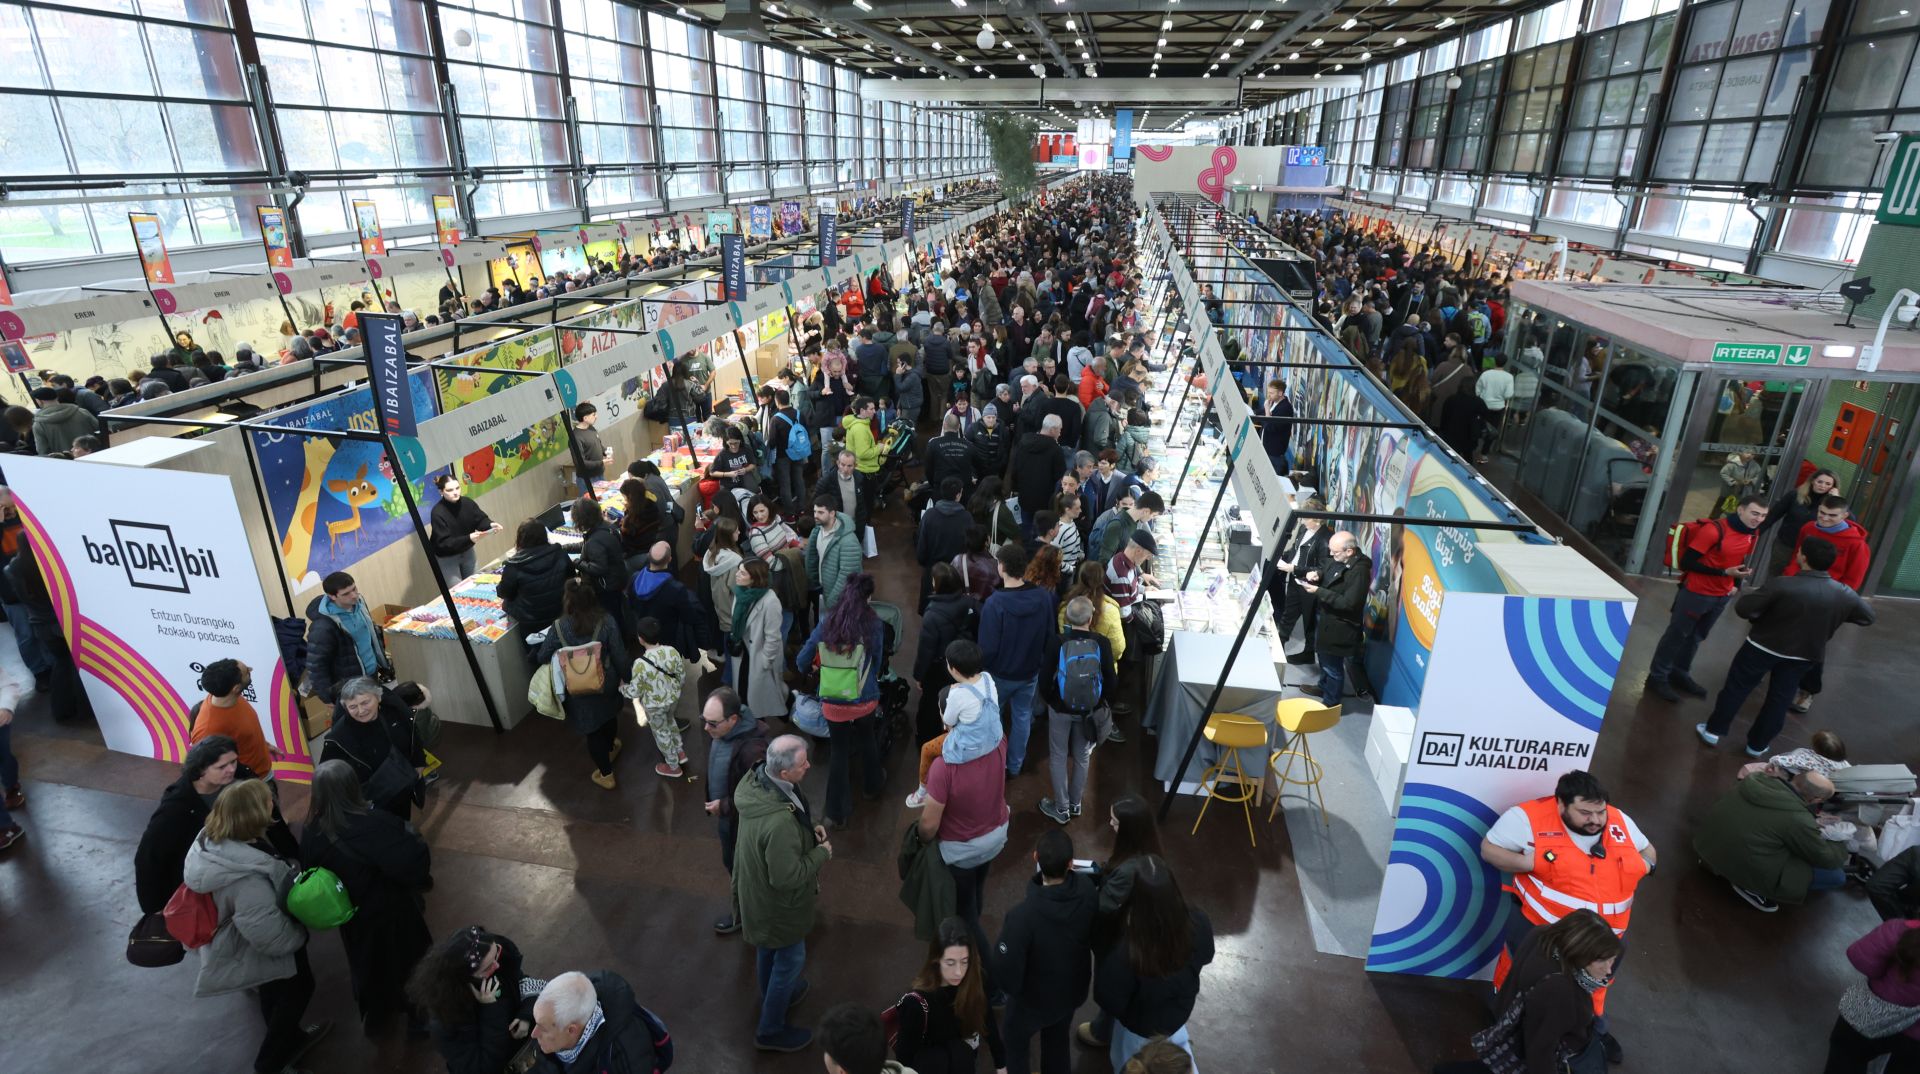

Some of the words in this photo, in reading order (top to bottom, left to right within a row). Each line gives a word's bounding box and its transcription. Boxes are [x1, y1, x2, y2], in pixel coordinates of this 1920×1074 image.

[824, 218, 835, 259] IBAIZABAL
[730, 239, 742, 290] IBAIZABAL
[214, 290, 231, 298] EREIN
[74, 310, 96, 320] EREIN
[591, 331, 617, 354] AIZA
[1715, 347, 1776, 360] IRTEERA
[384, 321, 399, 415] IBAIZABAL
[603, 361, 628, 378] IBAIZABAL
[564, 383, 572, 395] 2
[285, 409, 333, 429] IBAIZABAL
[468, 413, 508, 437] IBAIZABAL
[407, 450, 416, 464] 1
[728, 454, 748, 468] ROCK
[1421, 574, 1444, 609] Bizi
[150, 608, 183, 623] Entzun
[184, 613, 235, 630] Durangoko
[157, 624, 196, 639] Azokako
[197, 630, 240, 645] podcasta
[1425, 741, 1456, 757] DA!
[1469, 736, 1590, 758] KULTURAREN
[1465, 752, 1548, 772] JAIALDIA
